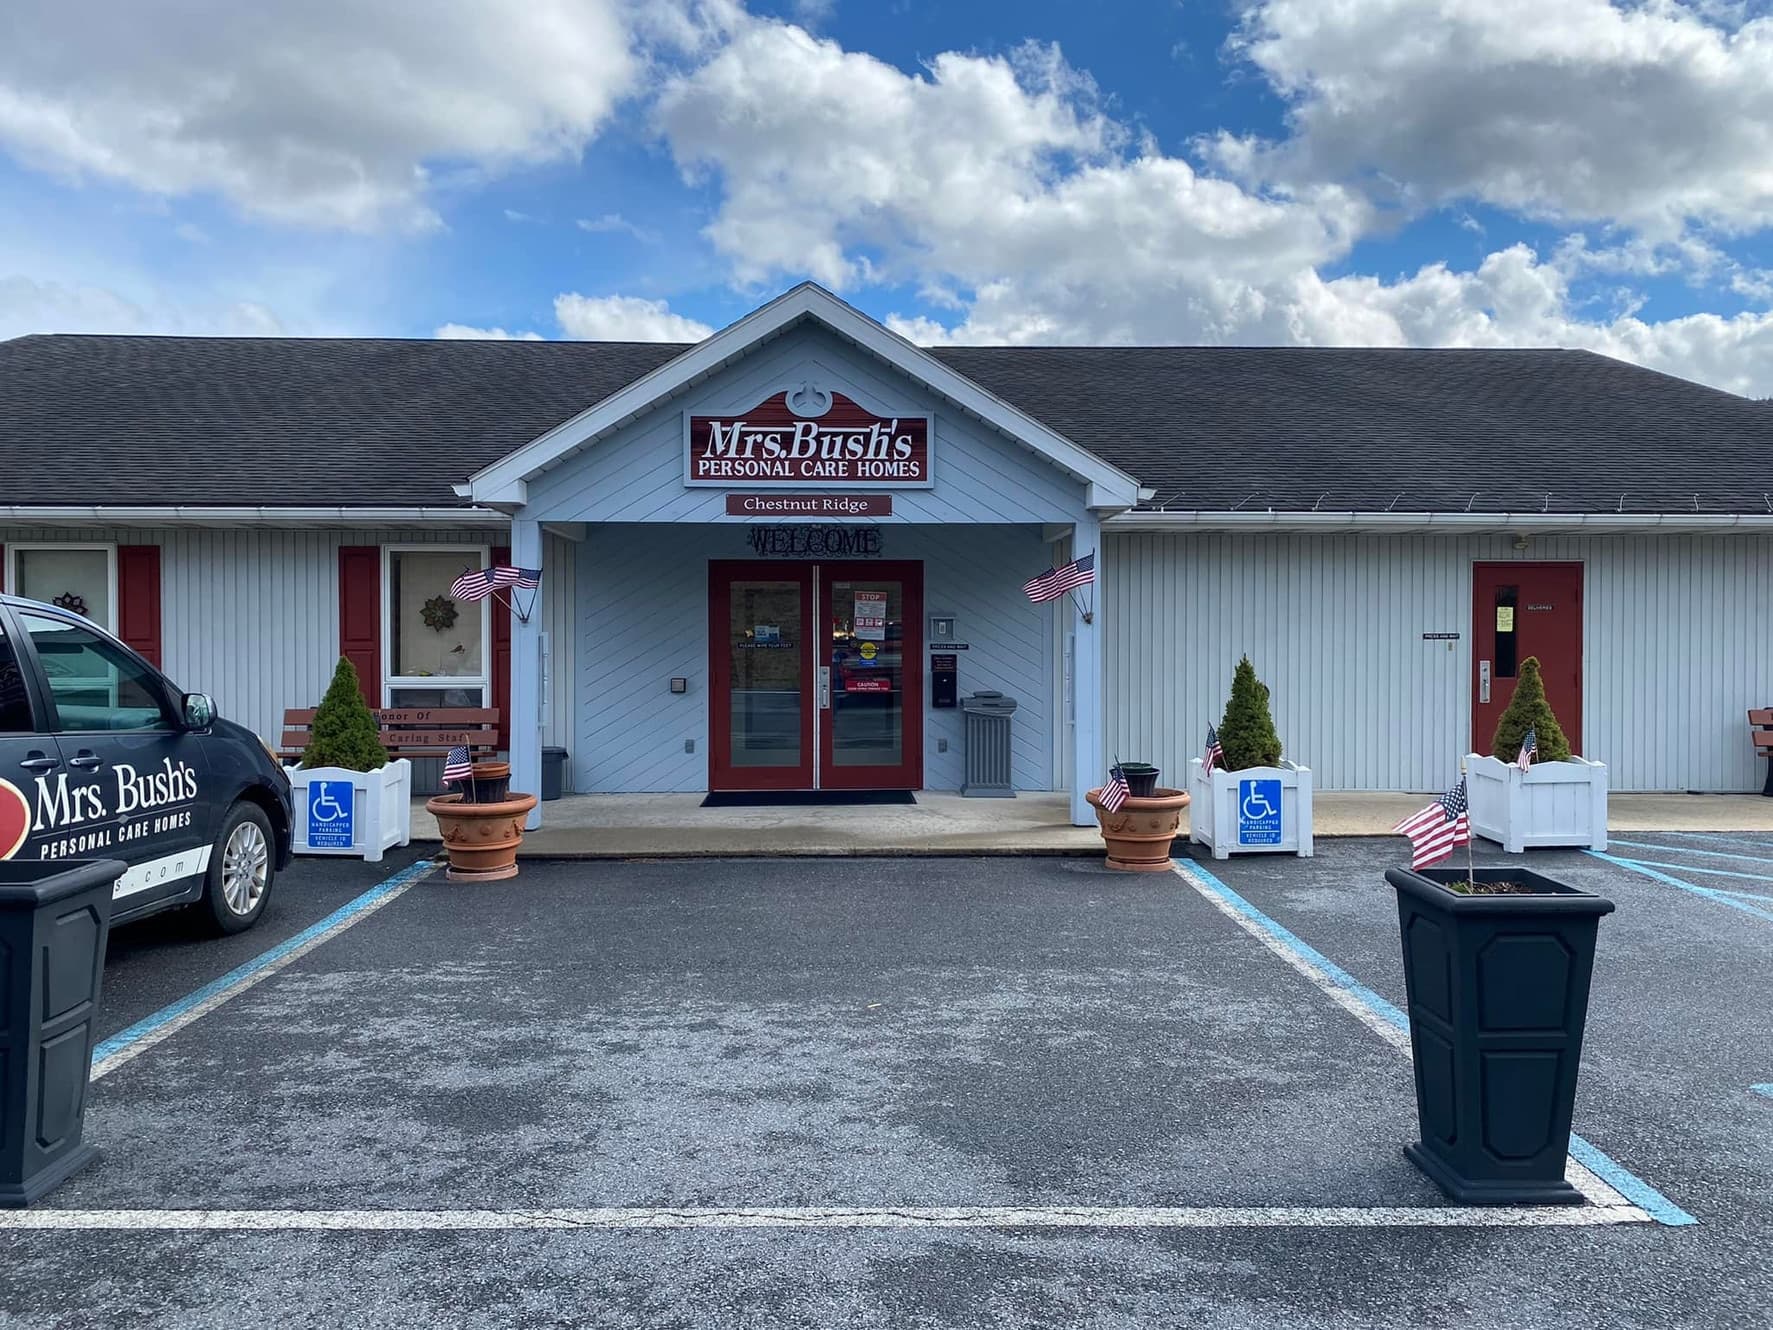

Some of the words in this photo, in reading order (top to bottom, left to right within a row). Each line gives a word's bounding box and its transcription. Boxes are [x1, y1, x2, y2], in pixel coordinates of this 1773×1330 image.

[701, 421, 787, 460] Mrs.
[787, 418, 913, 461] Bush's
[698, 460, 794, 477] PERSONAL
[801, 460, 849, 477] CARE
[857, 461, 920, 478] HOMES
[743, 498, 818, 511] Chestnut
[822, 498, 868, 514] Ridge
[752, 527, 880, 555] WELCOME
[416, 711, 431, 720] Of
[389, 733, 429, 744] Caring
[32, 773, 107, 831] Mrs.
[112, 757, 198, 813] Bush's
[40, 829, 112, 861] PERSONAL
[118, 821, 149, 842] CARE
[154, 811, 191, 834] HOMES
